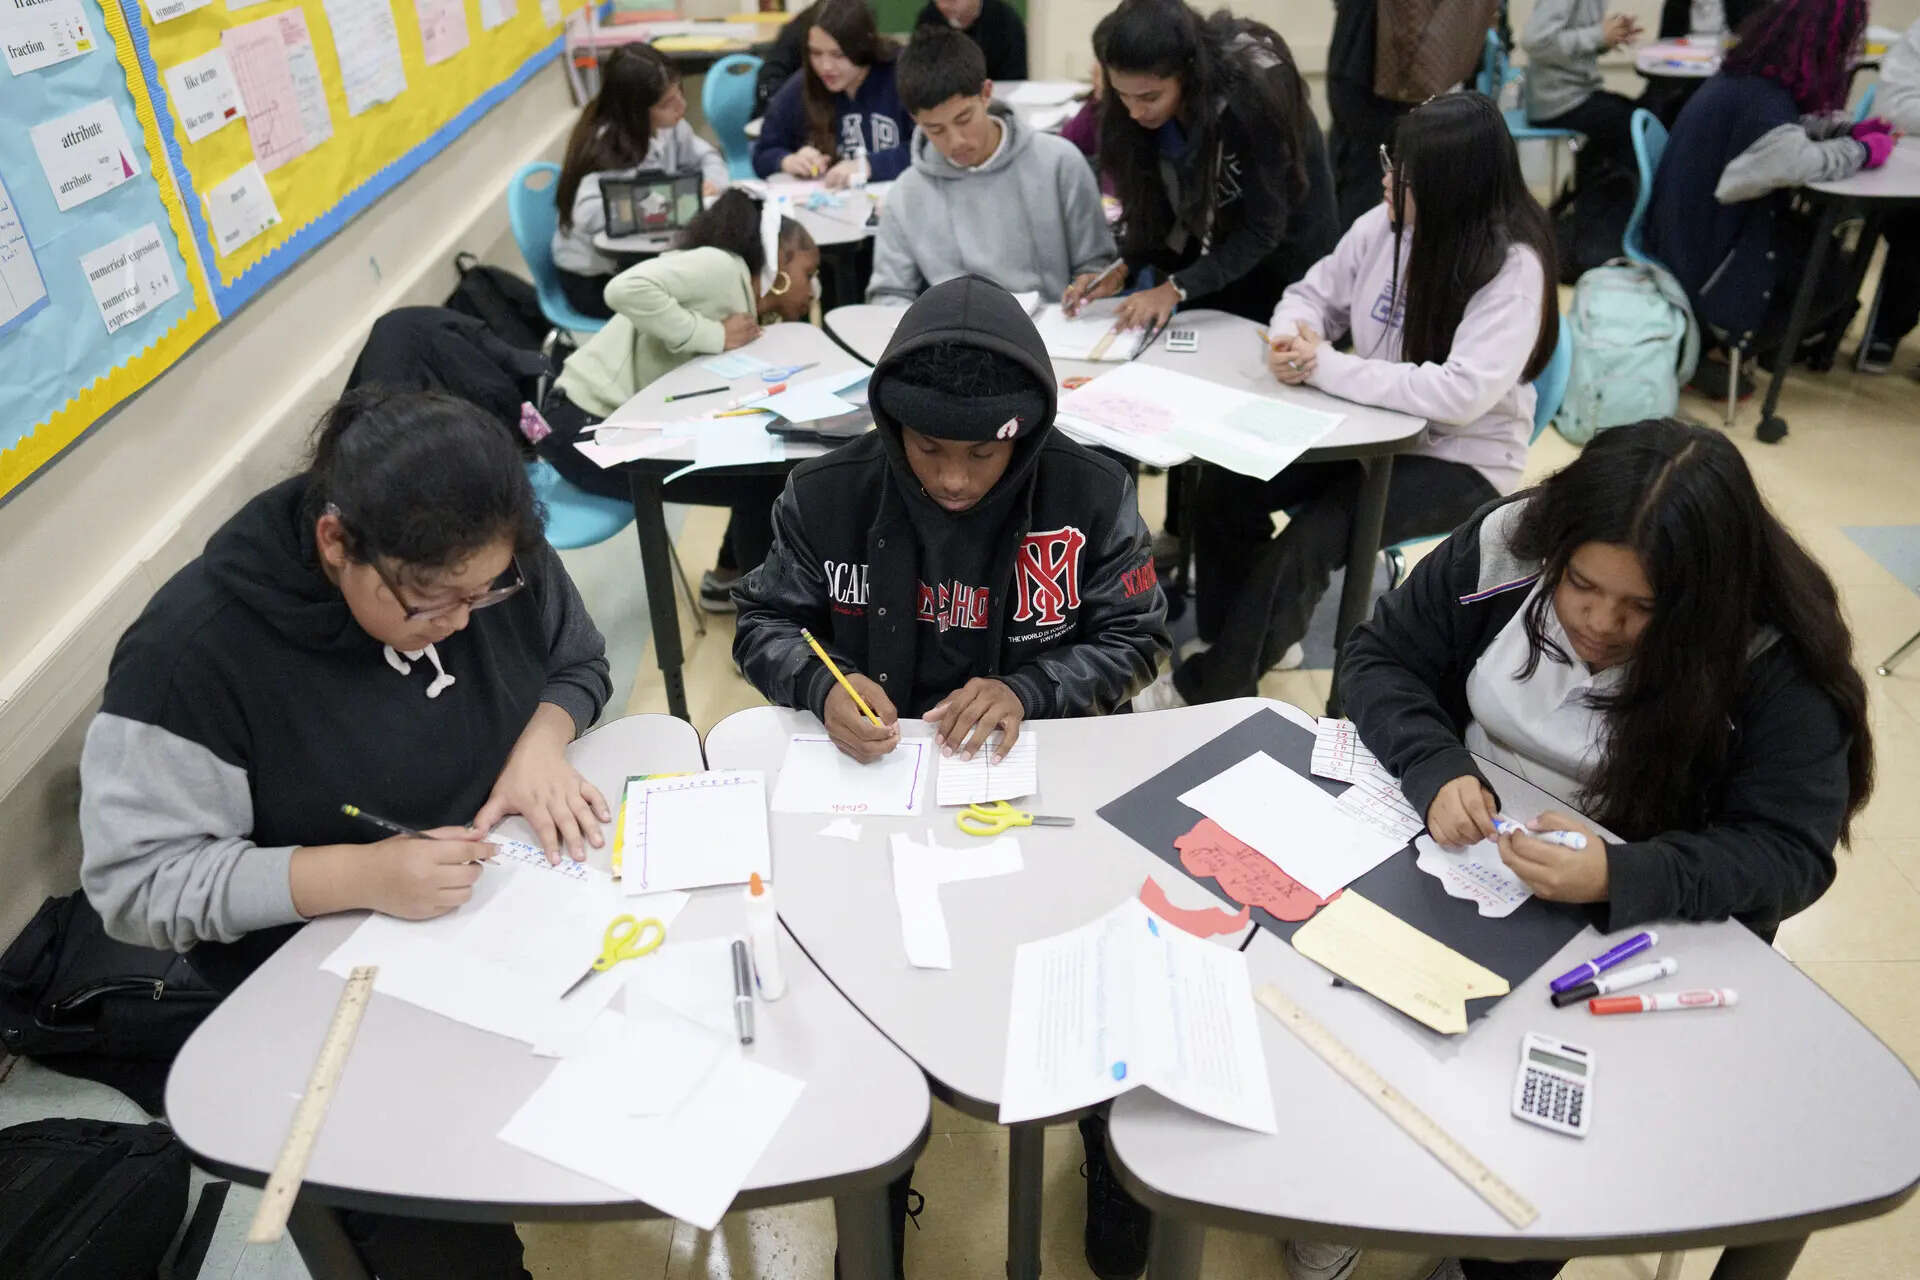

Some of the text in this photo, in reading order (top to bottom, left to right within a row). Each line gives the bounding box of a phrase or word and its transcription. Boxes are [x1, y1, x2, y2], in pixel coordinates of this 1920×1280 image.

[8, 40, 45, 58] fraction
[61, 121, 103, 149] attribute
[59, 173, 92, 194] attribute
[90, 239, 160, 281] numerical expression
[101, 281, 140, 311] numerical
[1021, 631, 1043, 641] WORLD
